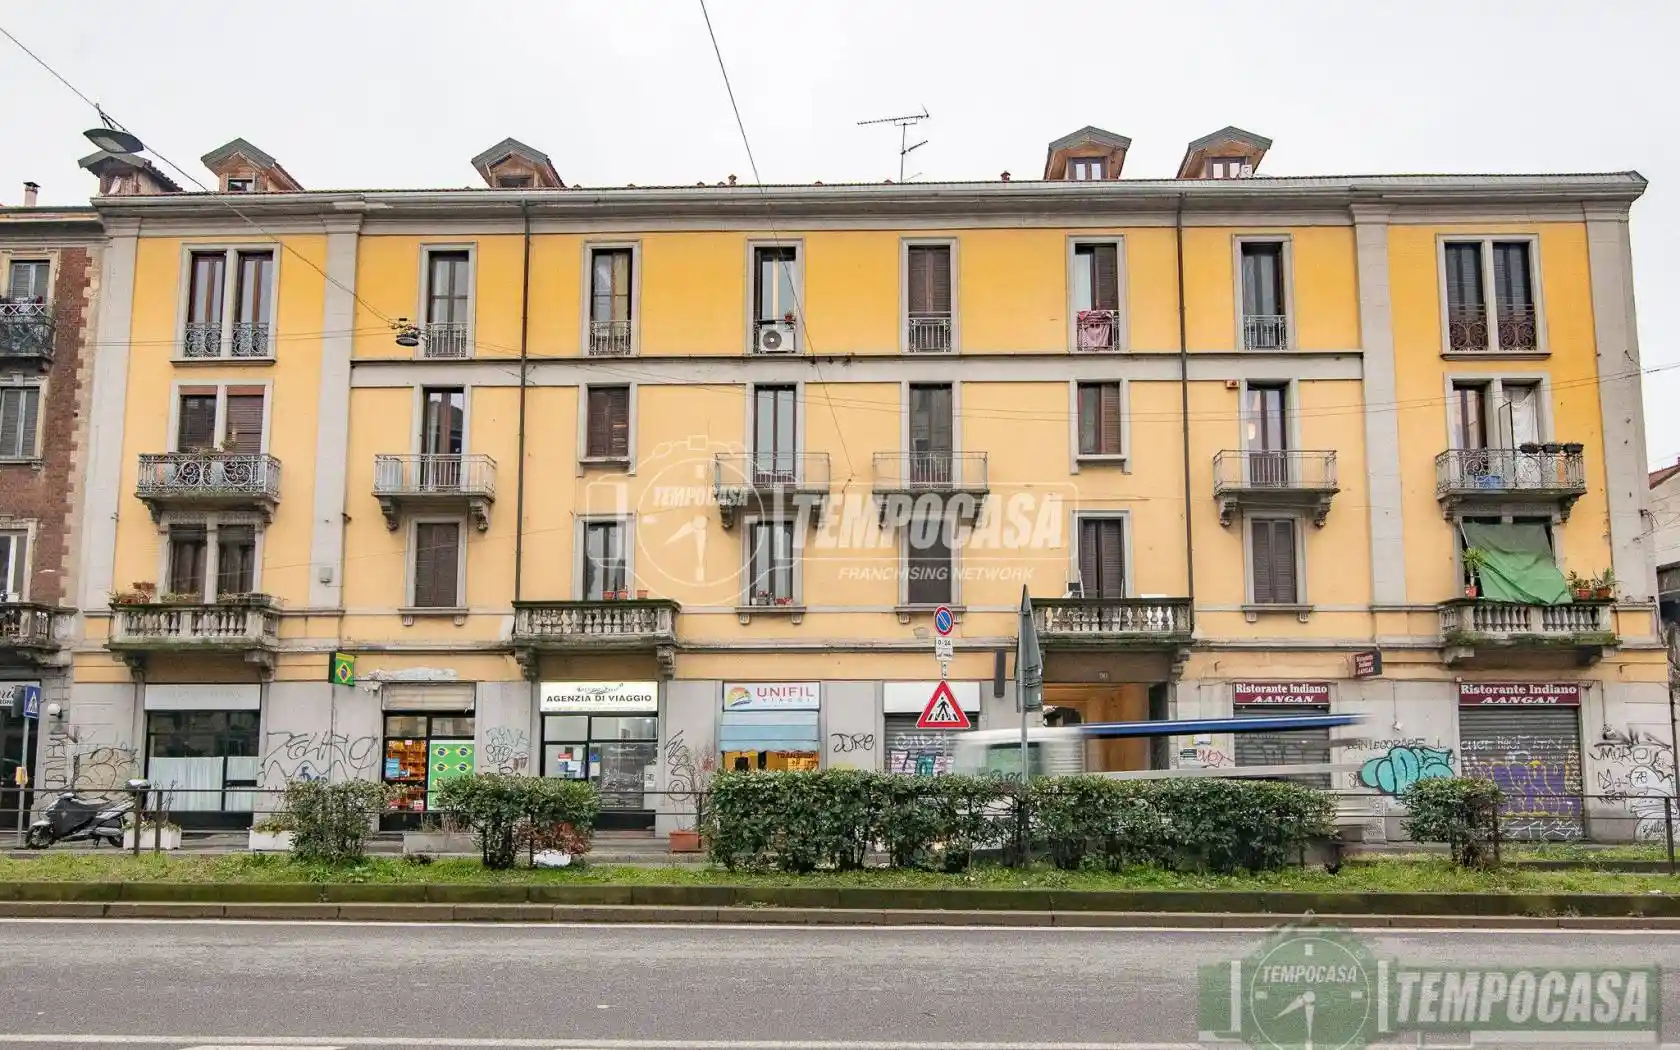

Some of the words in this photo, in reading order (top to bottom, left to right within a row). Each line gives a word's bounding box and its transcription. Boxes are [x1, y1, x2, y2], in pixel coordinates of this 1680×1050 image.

[757, 687, 815, 697] UNIFIL
[1236, 683, 1288, 693] Ristorante
[1290, 683, 1328, 693] Indiano
[1461, 684, 1526, 694] Ristorante
[1529, 684, 1577, 694] Indiano
[608, 694, 652, 702] VIAGGIO
[1252, 695, 1314, 703] AANGAN
